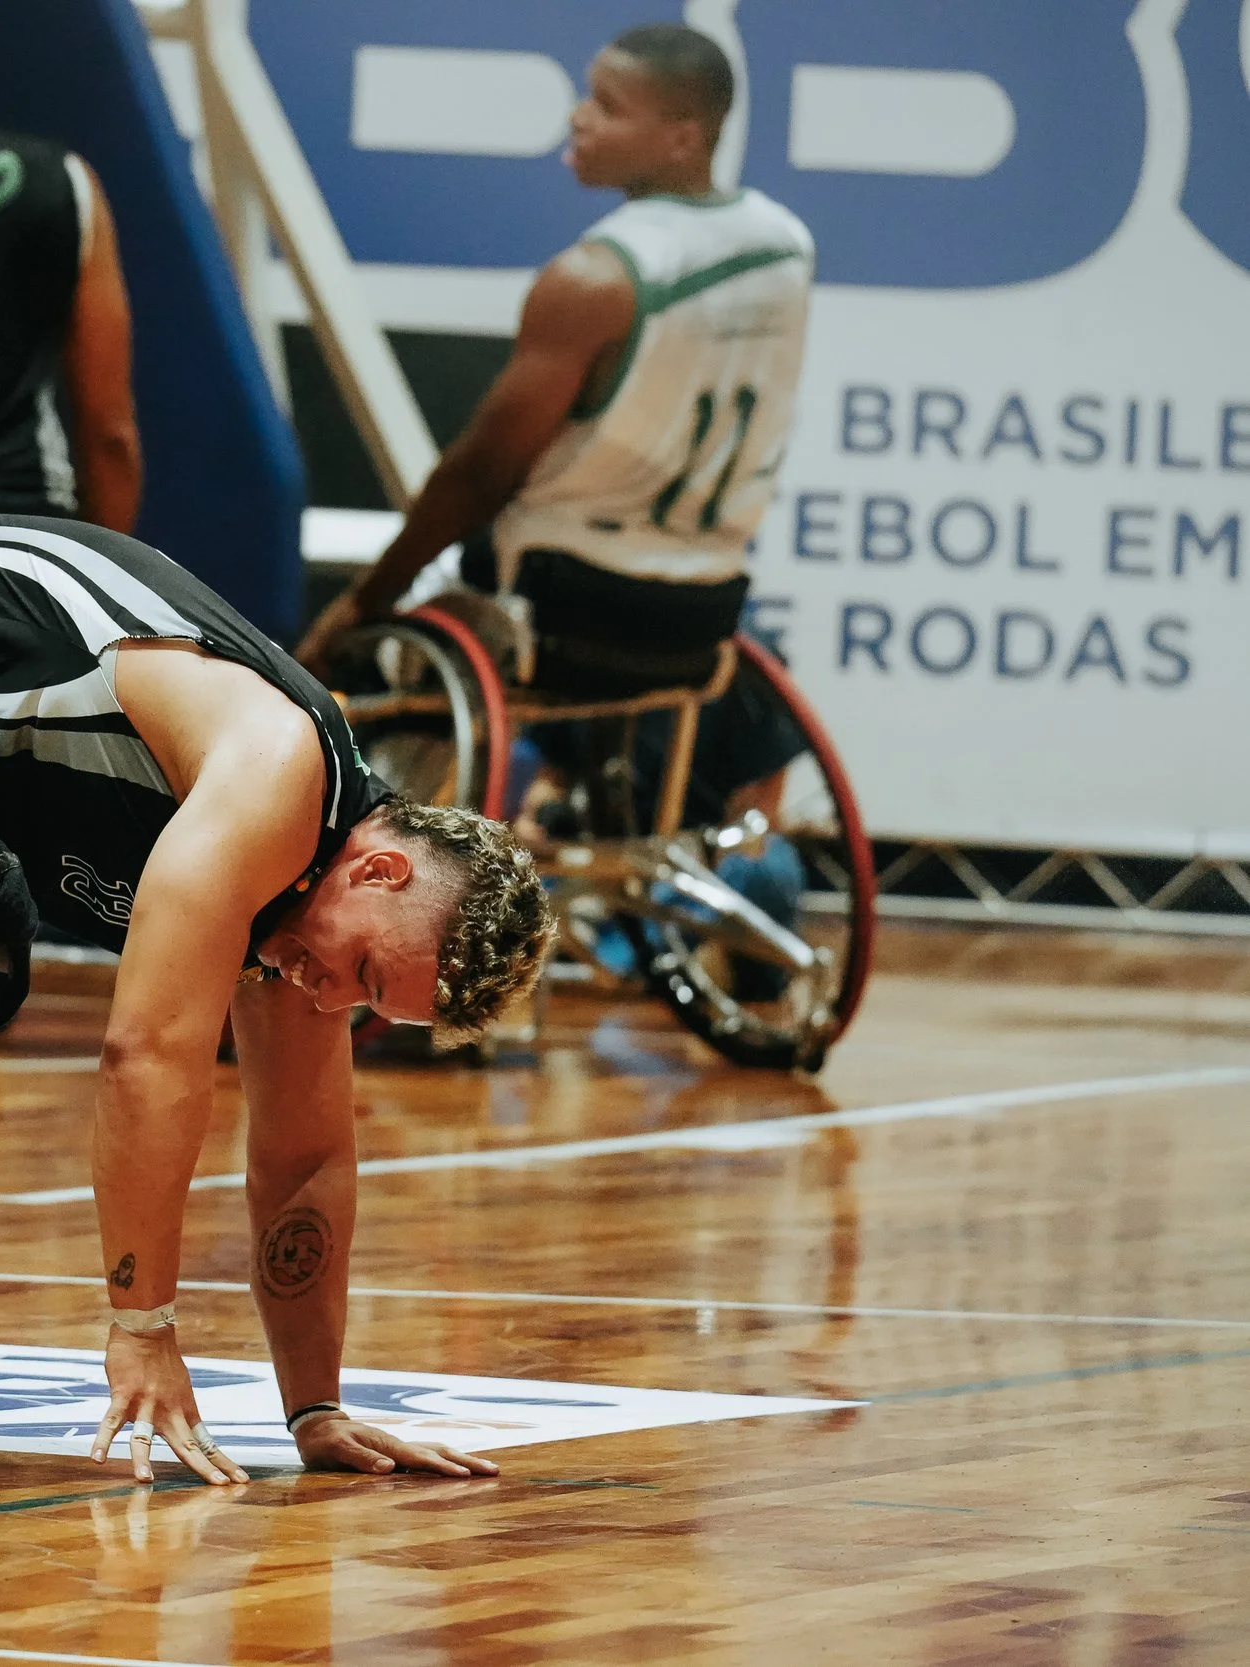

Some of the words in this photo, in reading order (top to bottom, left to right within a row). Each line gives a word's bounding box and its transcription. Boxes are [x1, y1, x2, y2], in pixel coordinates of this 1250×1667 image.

[649, 384, 757, 529] 11
[744, 493, 1059, 571] EBOL
[1107, 507, 1241, 580] EM
[838, 602, 1192, 688] RODAS
